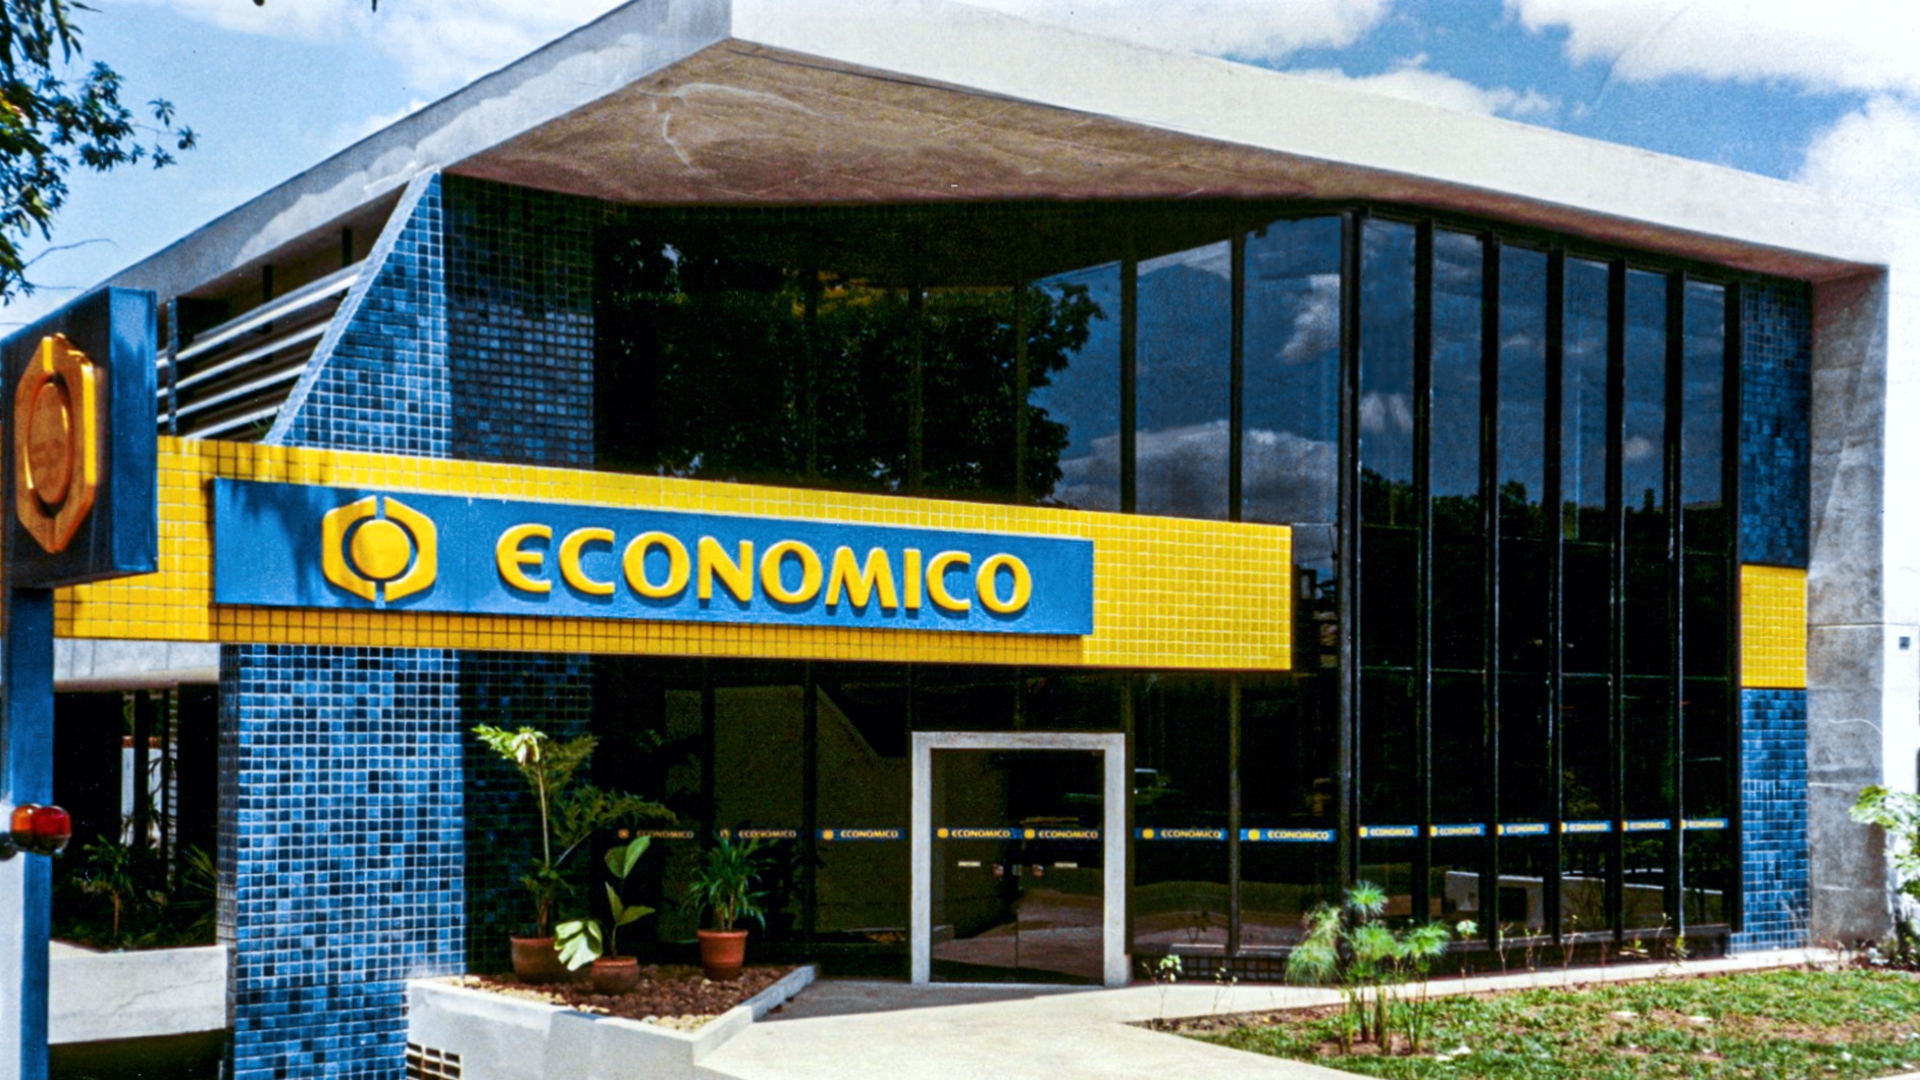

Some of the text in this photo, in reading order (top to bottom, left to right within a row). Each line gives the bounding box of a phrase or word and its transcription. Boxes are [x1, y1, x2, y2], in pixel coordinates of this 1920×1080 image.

[495, 523, 1032, 613] ECONOMICO
[840, 829, 898, 839] ECONOMICO
[952, 829, 1010, 839] ECONOMICO
[1038, 830, 1098, 839] ECONOMICO
[1161, 829, 1221, 839] ECONOMICO
[1267, 830, 1330, 840] ECONOMICO
